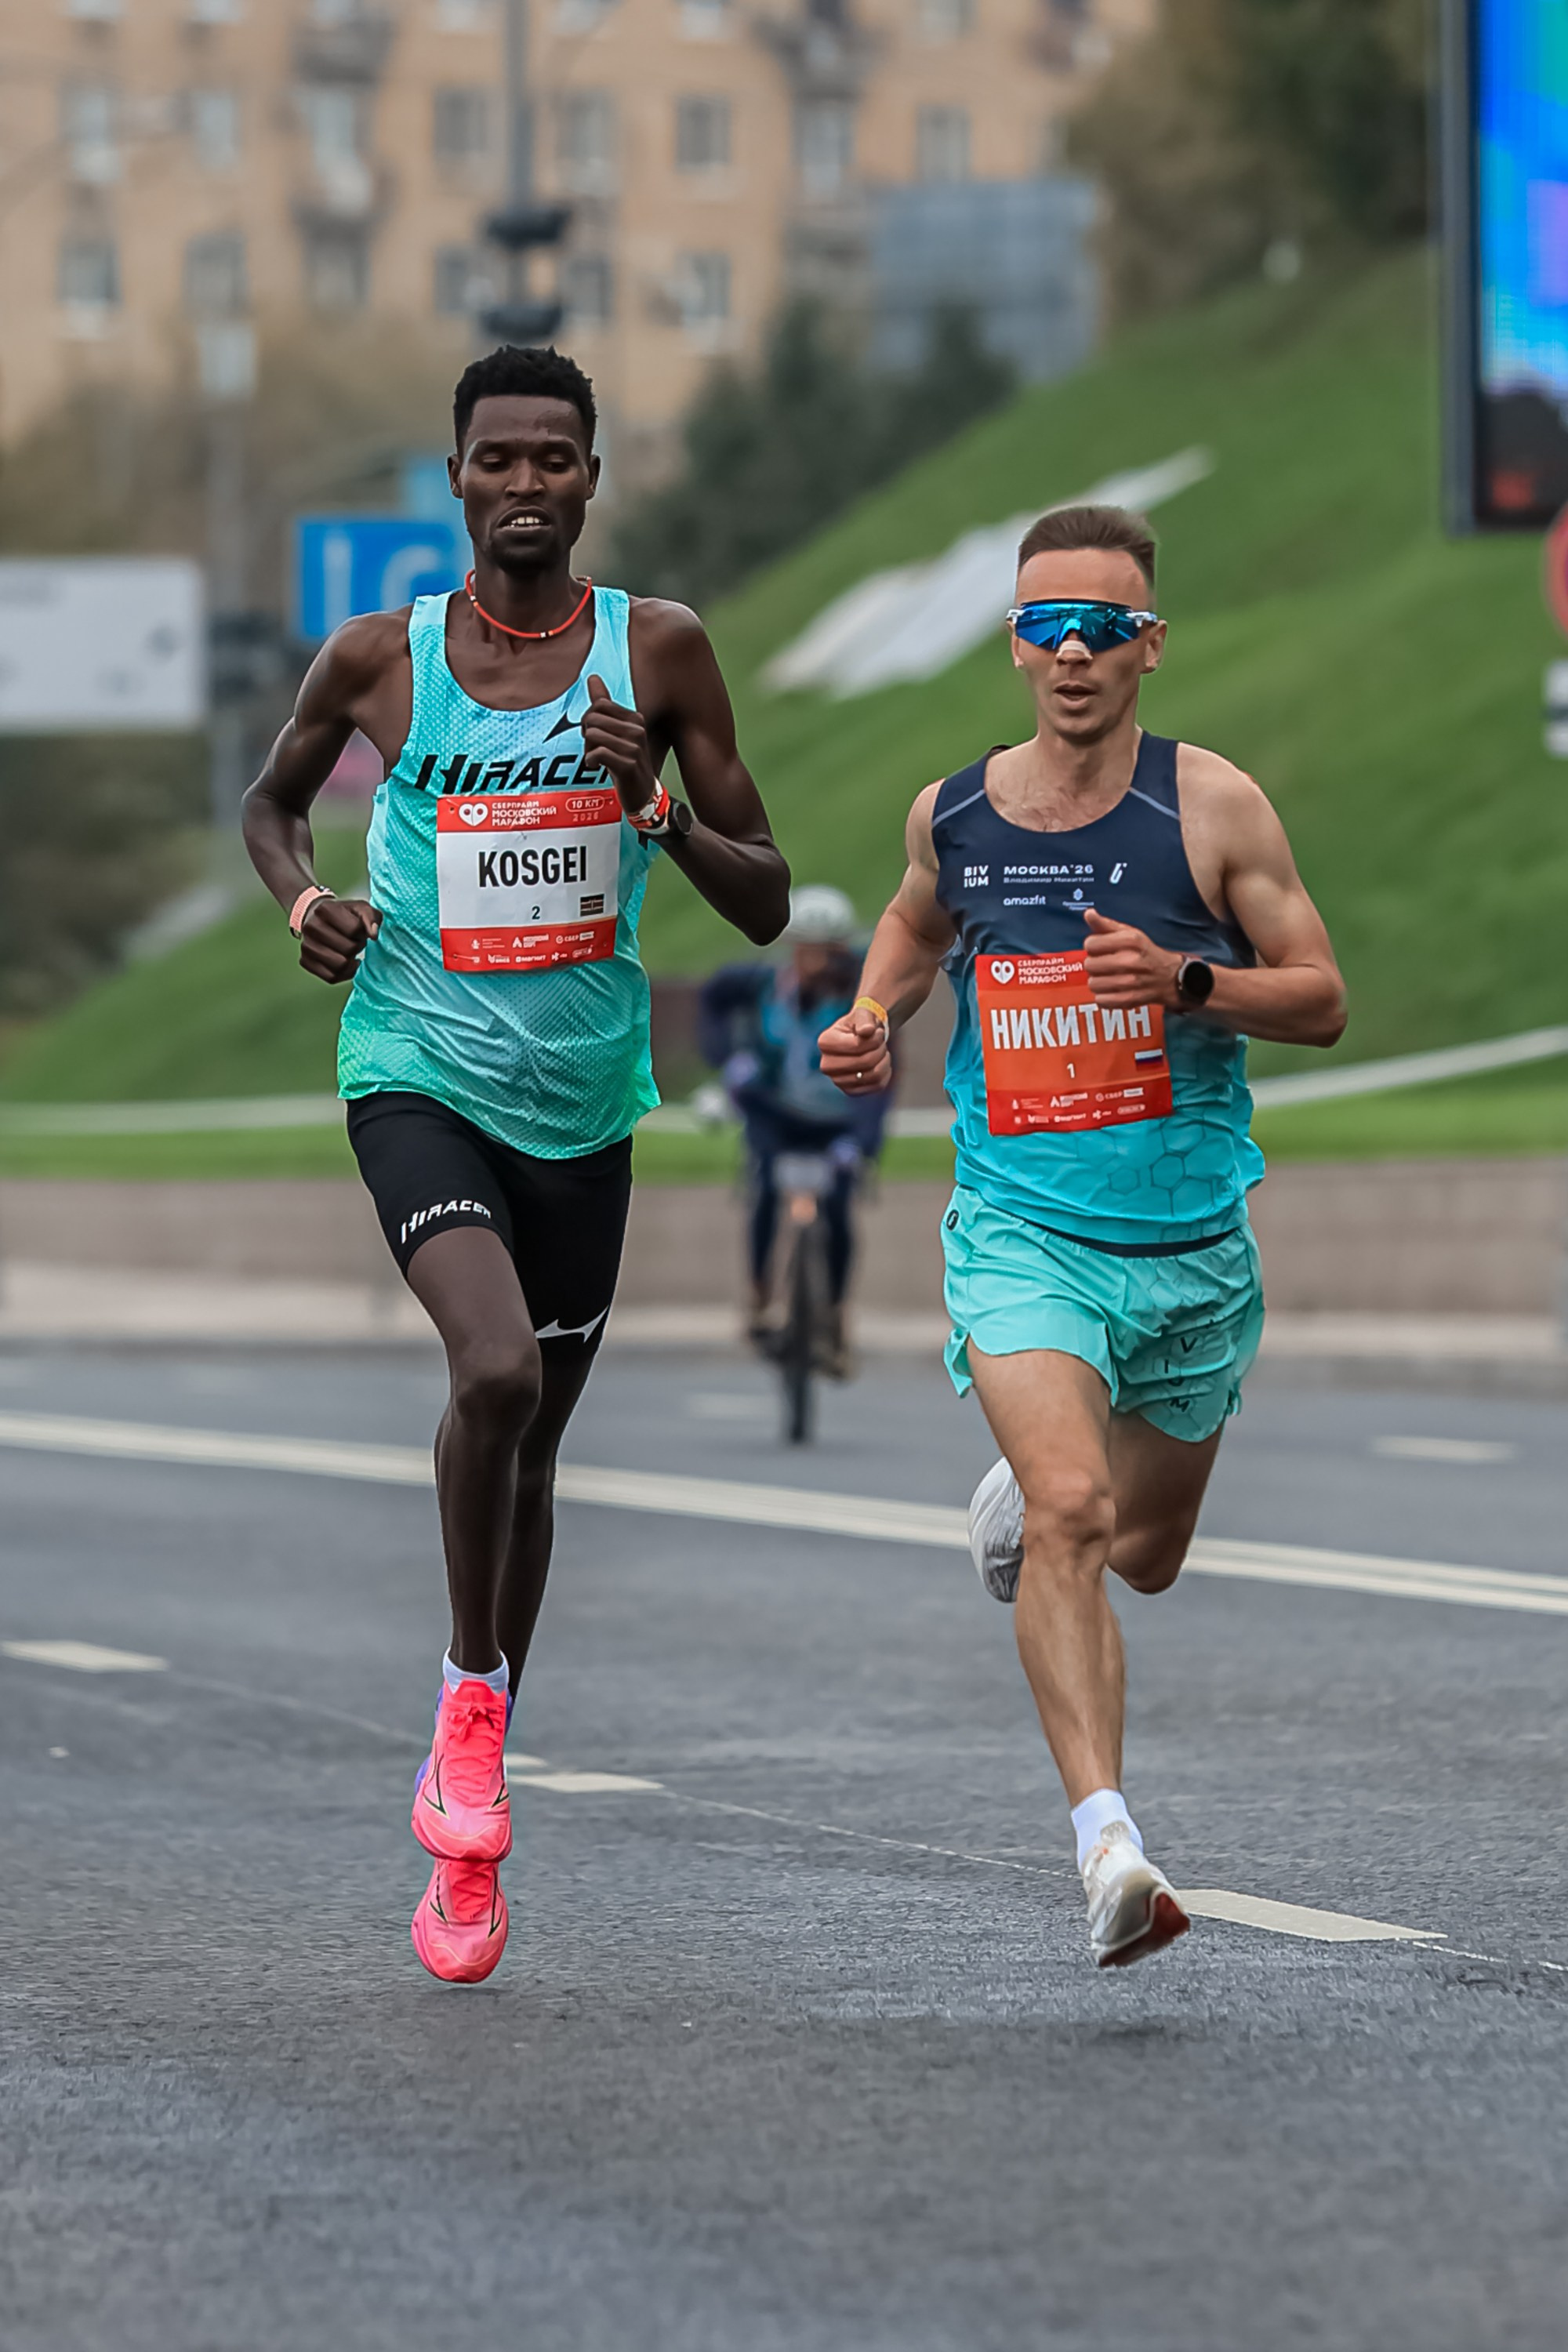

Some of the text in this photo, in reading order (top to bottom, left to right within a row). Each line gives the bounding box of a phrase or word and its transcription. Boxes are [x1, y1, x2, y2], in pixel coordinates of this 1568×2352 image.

[492, 800, 539, 809] СБЕРПРАЙМ
[572, 800, 583, 809] 10
[492, 806, 557, 818] МОСКОВСКИЙ
[572, 811, 599, 822] 2026
[492, 817, 540, 826] МАРАФОН
[478, 845, 587, 887] KOSGEI
[964, 865, 989, 877] BIV
[964, 876, 989, 887] IUM
[1003, 895, 1047, 906] amazfit
[532, 906, 540, 920] 2
[1018, 957, 1065, 967] СБЕРПРАЙМ
[1018, 962, 1083, 975] МОСКОВСКИЙ
[1018, 974, 1066, 985] МАРАФОН
[990, 1003, 1152, 1051] НИКИТИН
[1066, 1062, 1076, 1079] 1
